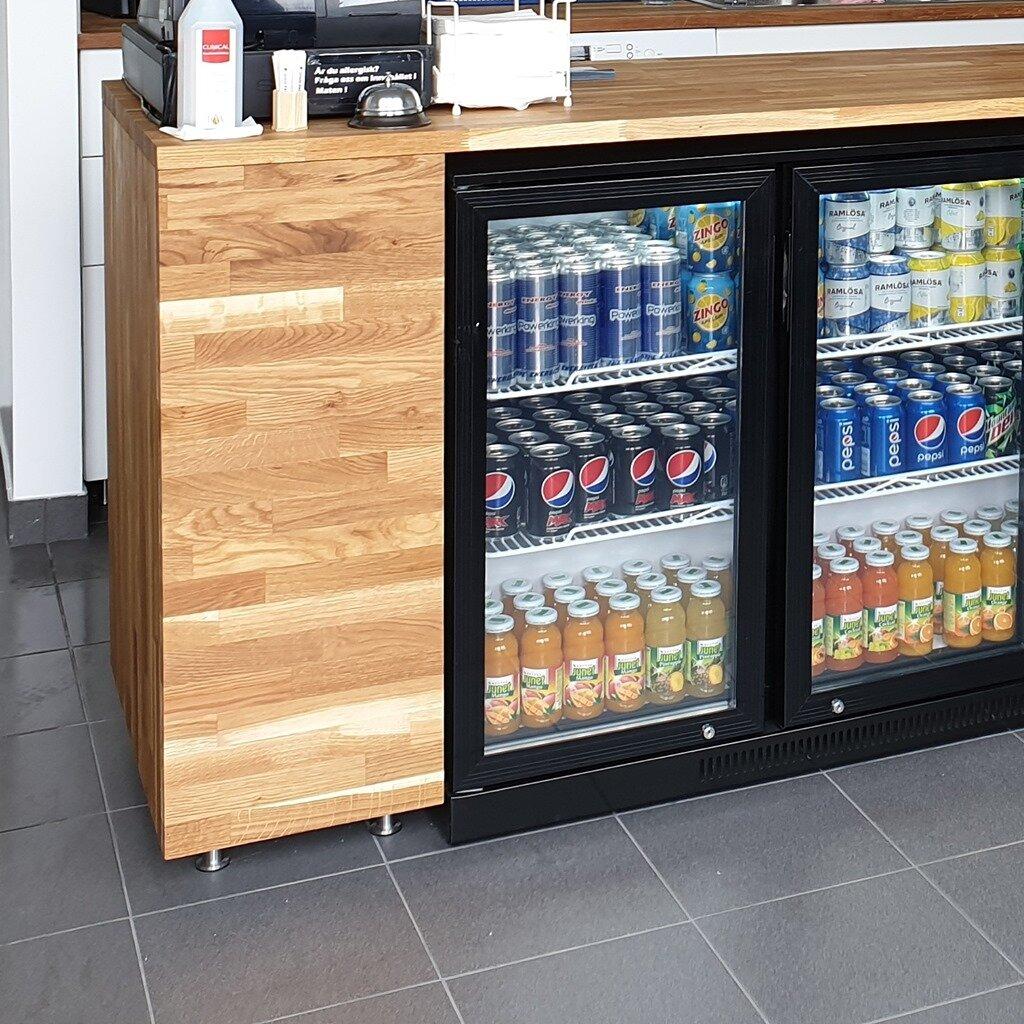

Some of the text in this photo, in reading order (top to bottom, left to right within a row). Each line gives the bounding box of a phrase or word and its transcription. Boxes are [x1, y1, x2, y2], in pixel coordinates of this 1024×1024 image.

[941, 196, 972, 207] AMLÖSA
[828, 209, 866, 217] RAMLÖSA
[693, 218, 729, 242] ZINGO
[826, 287, 864, 296] RAMLÖSA
[693, 298, 729, 322] ZINGO
[841, 418, 856, 472] pepsi
[886, 417, 902, 468] pepsi
[959, 443, 985, 456] pepsi
[917, 450, 945, 464] pepsi
